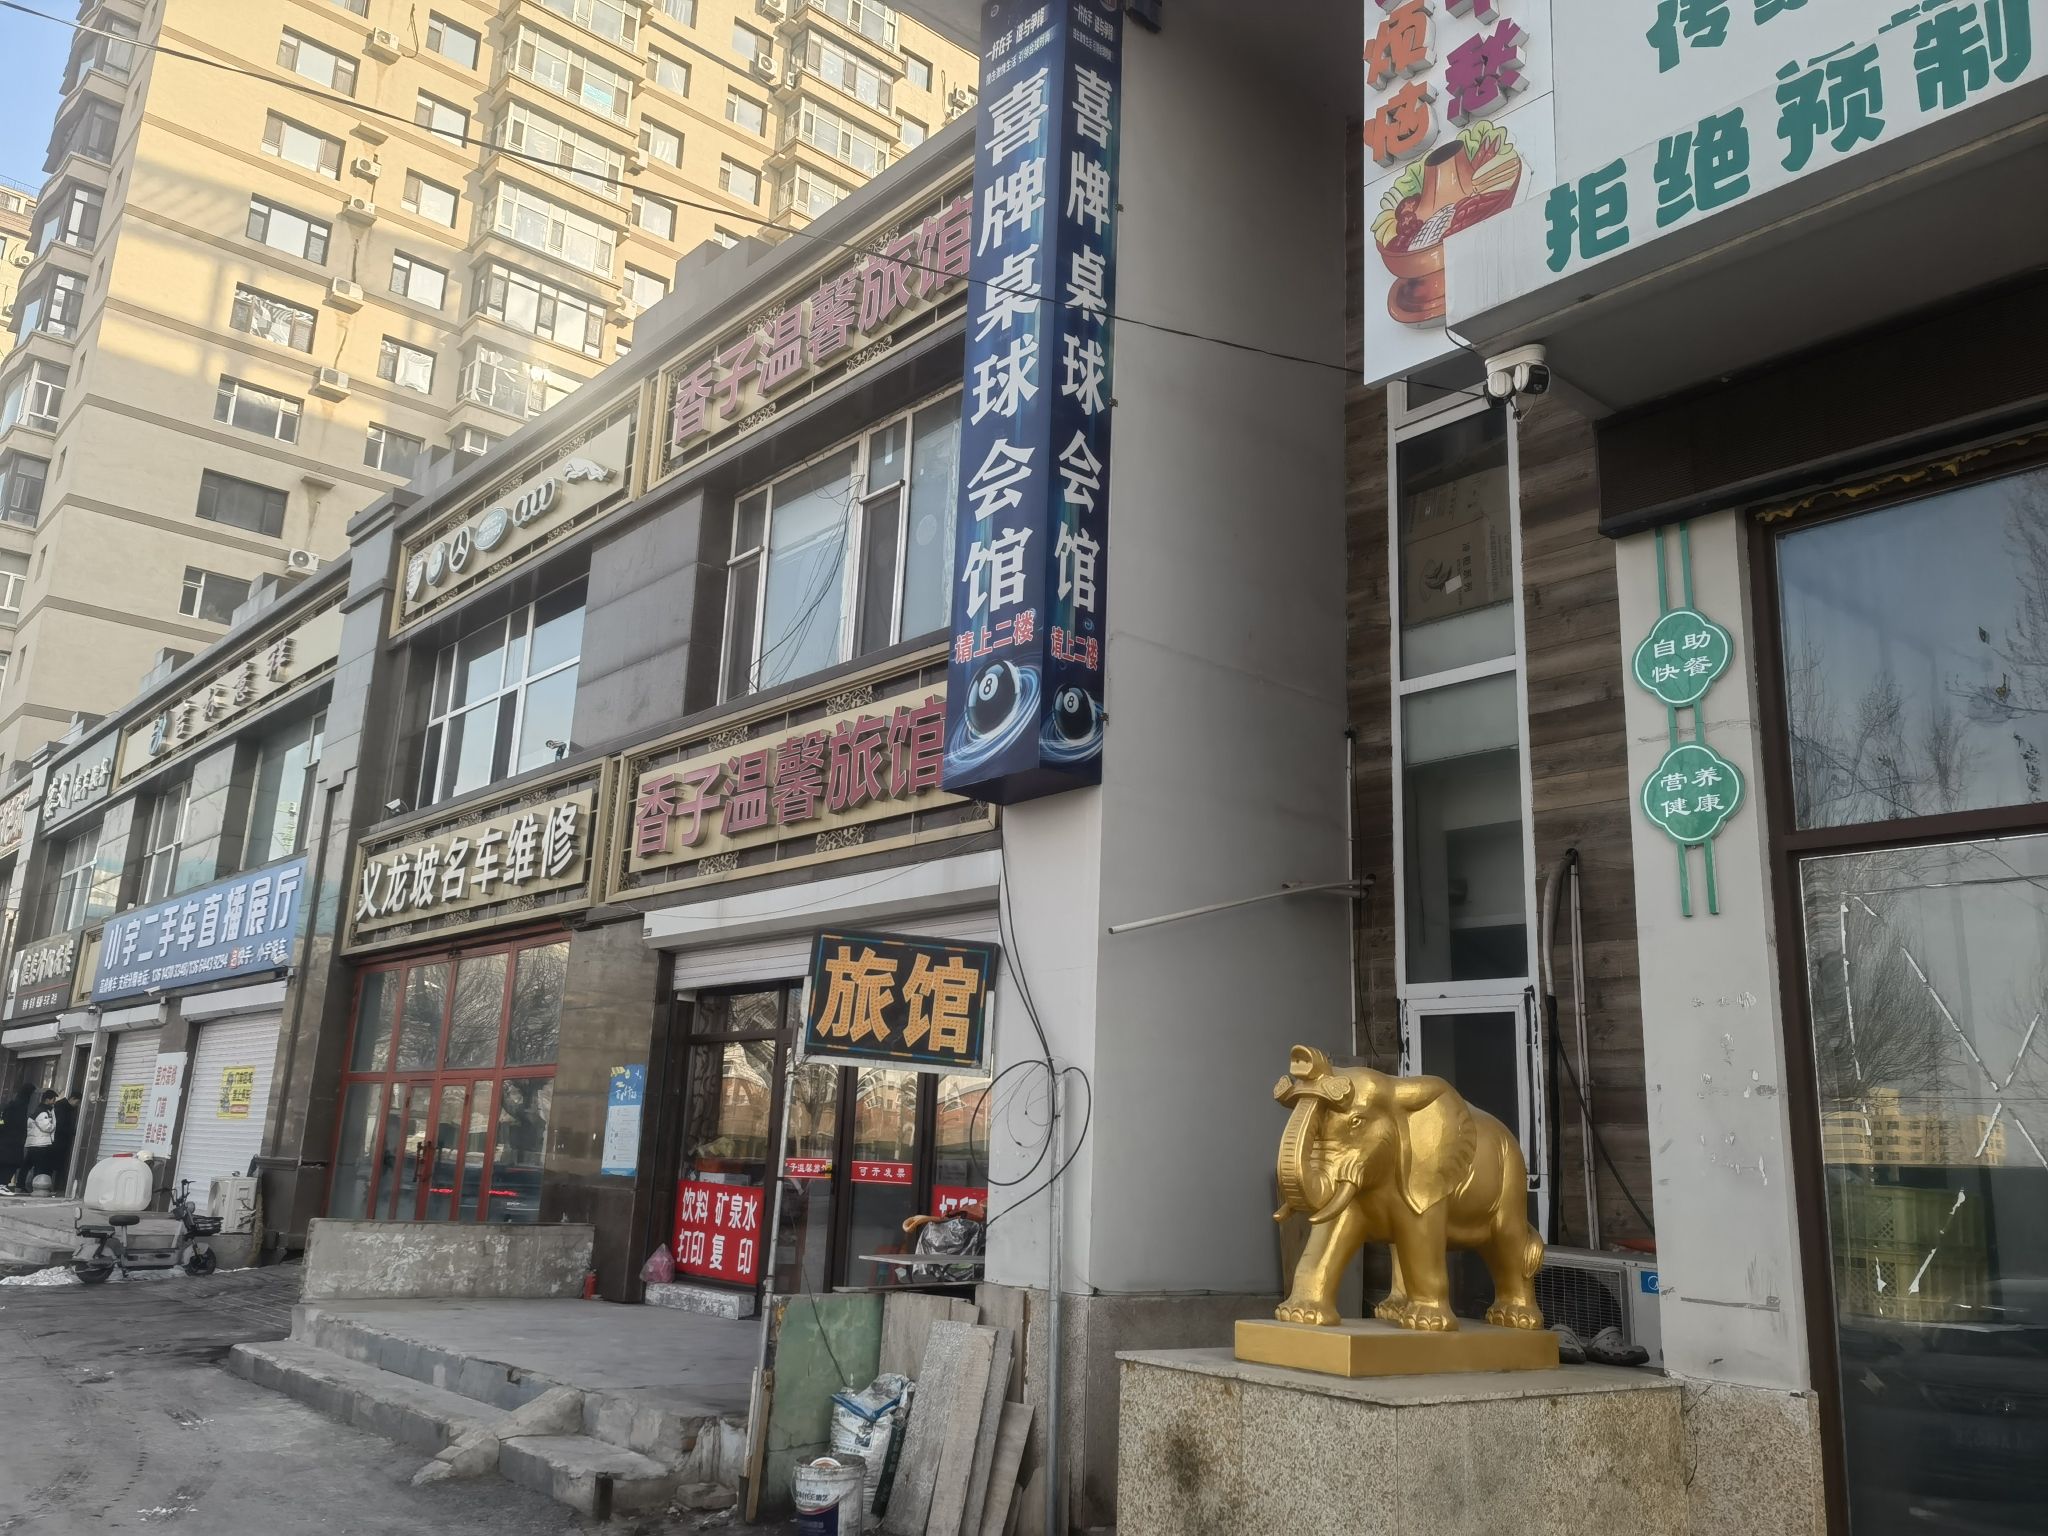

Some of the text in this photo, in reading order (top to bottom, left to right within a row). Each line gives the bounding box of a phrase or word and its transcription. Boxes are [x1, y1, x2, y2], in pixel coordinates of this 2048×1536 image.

[1544, 0, 2032, 273] 拒绝预制
[674, 195, 974, 446] 香子温馨旅馆
[961, 67, 1050, 619] 喜牌桌球会馆
[1053, 63, 1113, 613] 喜牌桌球会馆
[953, 610, 1035, 665] 请上二楼
[1050, 625, 1099, 671] 请上二楼
[1653, 630, 1712, 659] 自助
[1651, 655, 1713, 683] 快餐
[635, 695, 948, 859] 香子温馨旅馆
[1660, 766, 1722, 792] 营养
[1660, 793, 1725, 818] 健康
[355, 801, 577, 922] 义龙坡名车维修
[103, 866, 300, 970] 小宇二手车直播展厅
[815, 945, 980, 1054] 旅馆
[858, 1165, 907, 1179] 可开发票
[681, 1187, 759, 1232] 饮料 矿泉水
[676, 1228, 706, 1266] 打印
